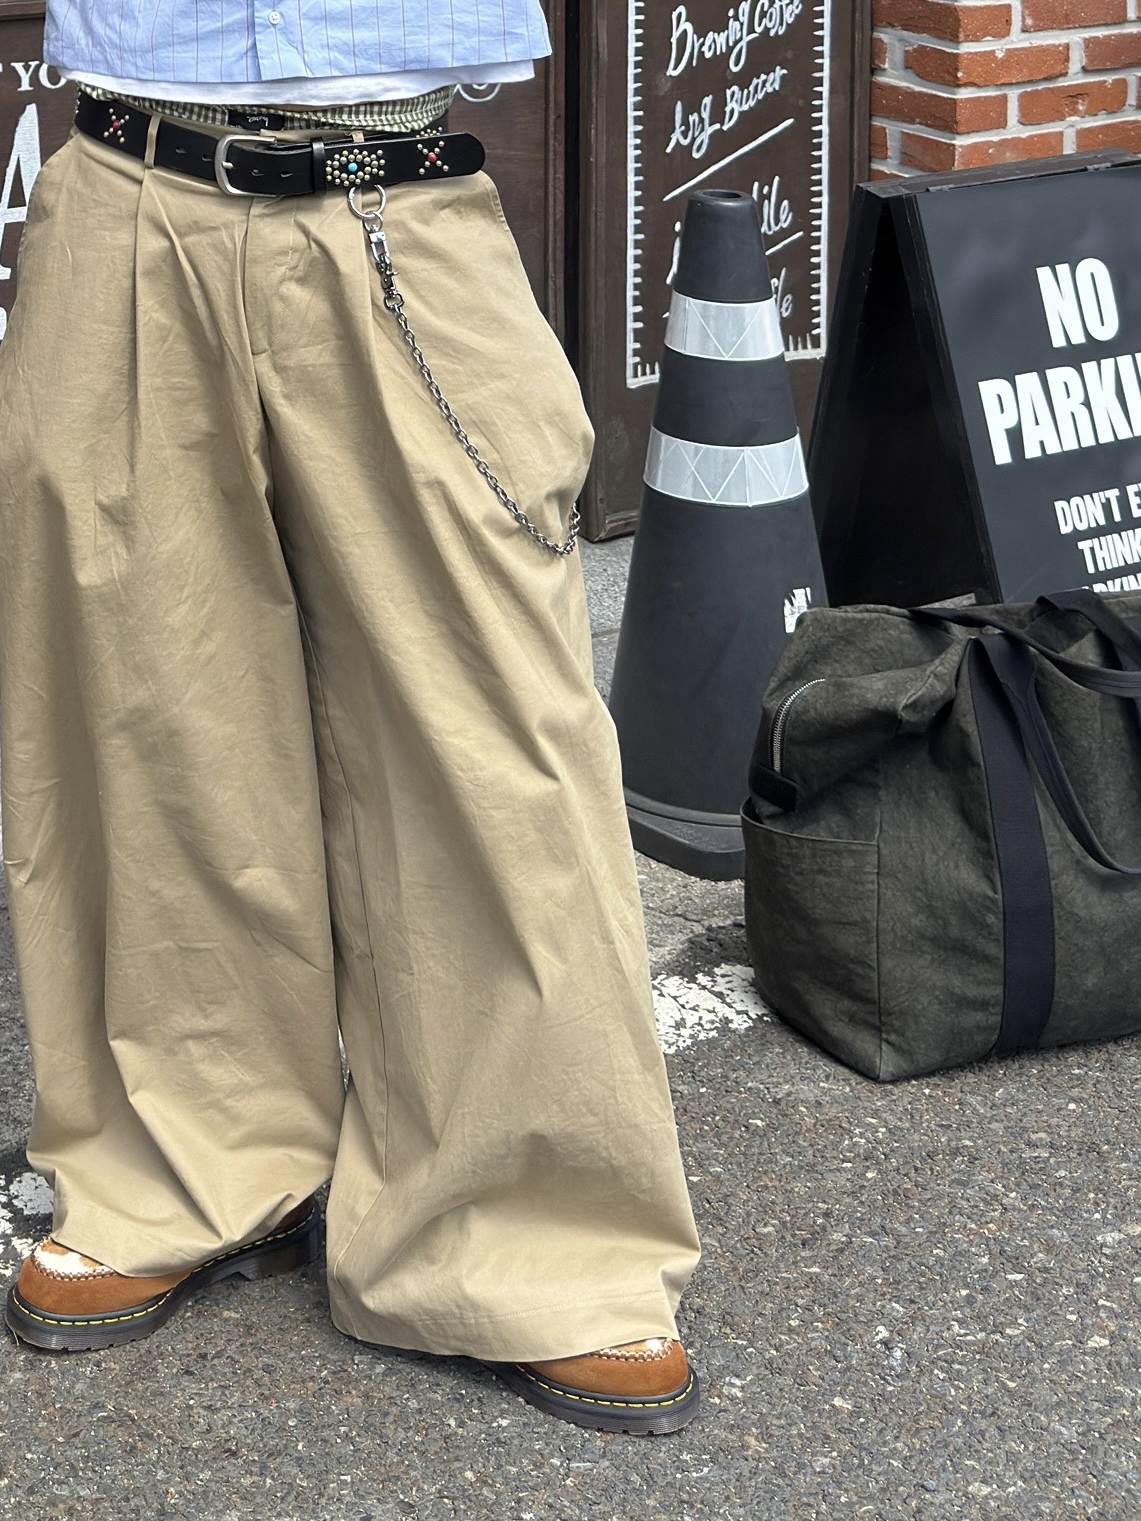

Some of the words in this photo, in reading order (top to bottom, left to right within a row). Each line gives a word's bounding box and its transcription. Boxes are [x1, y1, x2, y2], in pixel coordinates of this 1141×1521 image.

[666, 0, 759, 77] Brewing
[722, 65, 789, 131] Butter
[1035, 257, 1120, 348] NO
[977, 352, 1141, 466] PARKI
[1053, 488, 1121, 535] DON'T
[1125, 482, 1141, 519] E
